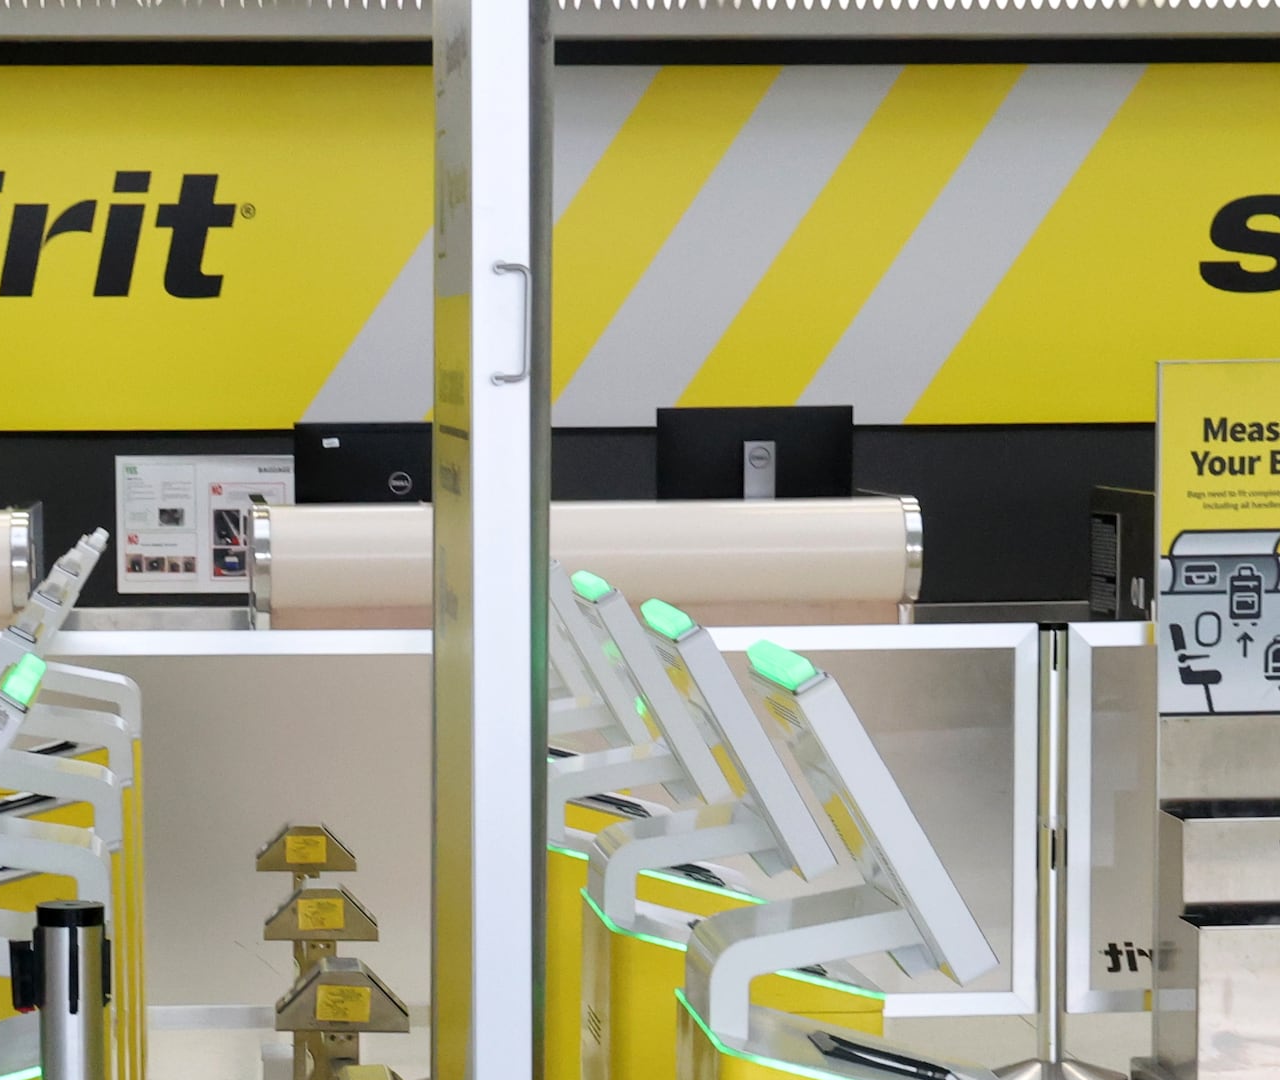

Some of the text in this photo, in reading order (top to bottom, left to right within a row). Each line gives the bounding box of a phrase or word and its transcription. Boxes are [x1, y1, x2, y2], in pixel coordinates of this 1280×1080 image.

[1191, 451, 1261, 476] Your
[1187, 490, 1206, 499] Bags
[1208, 490, 1227, 498] need
[1203, 501, 1239, 511] including
